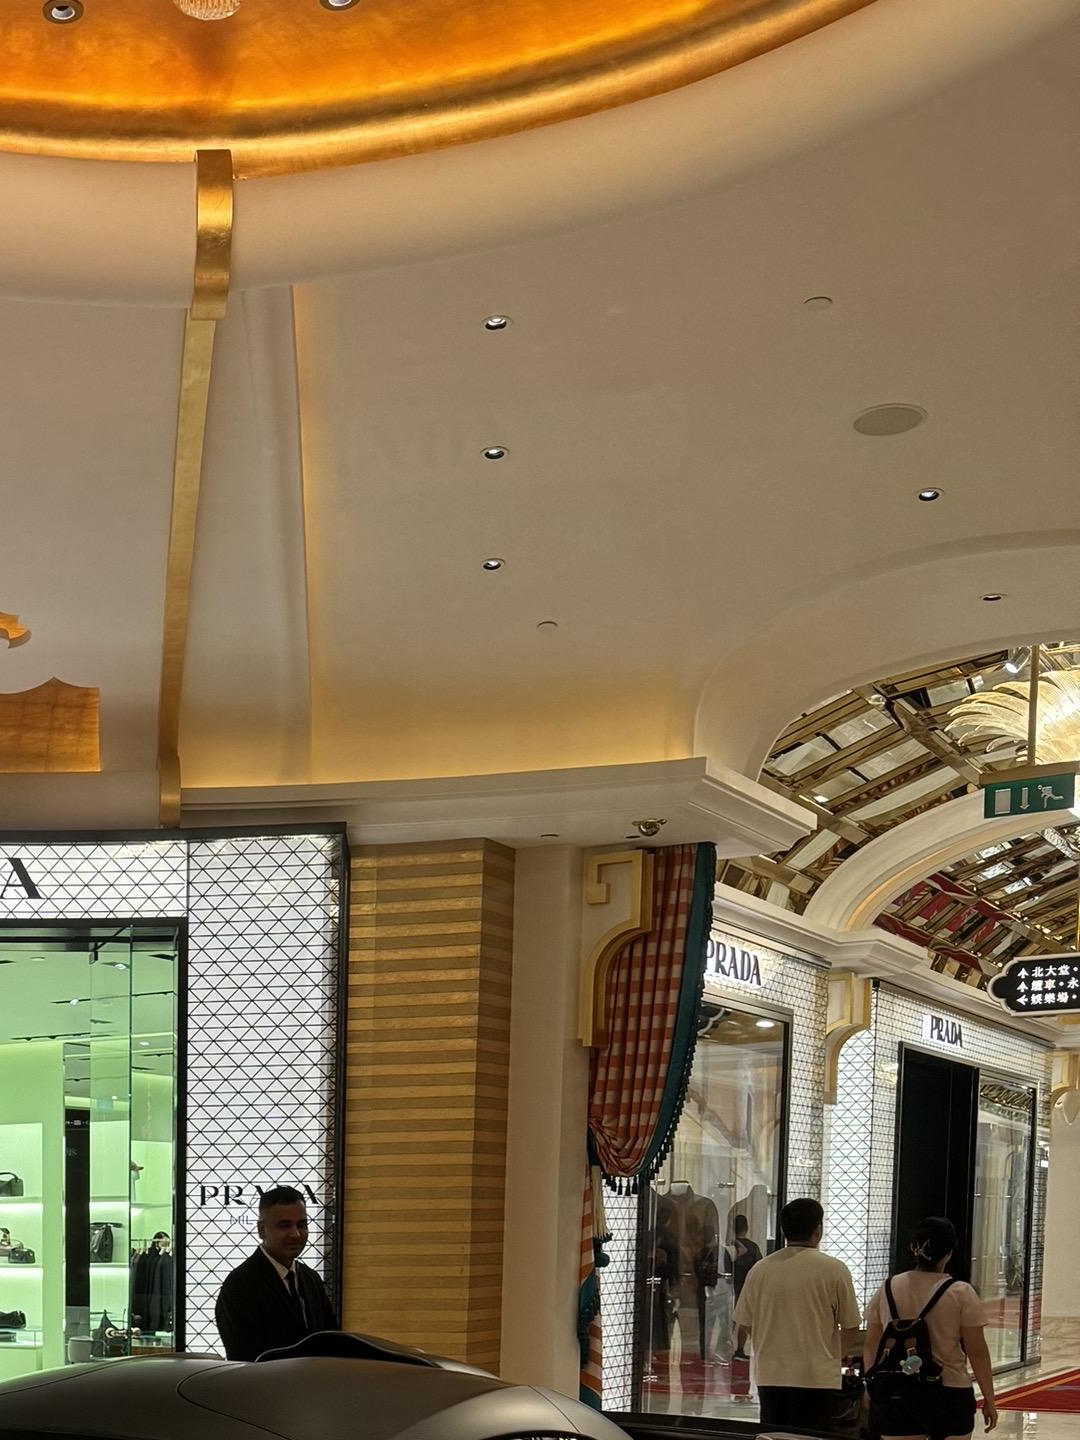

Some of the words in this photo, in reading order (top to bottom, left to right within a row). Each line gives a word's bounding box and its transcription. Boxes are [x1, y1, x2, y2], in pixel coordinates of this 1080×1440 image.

[705, 939, 762, 986] PRADA
[930, 1015, 963, 1048] PRADA
[199, 1184, 319, 1206] PRAA
